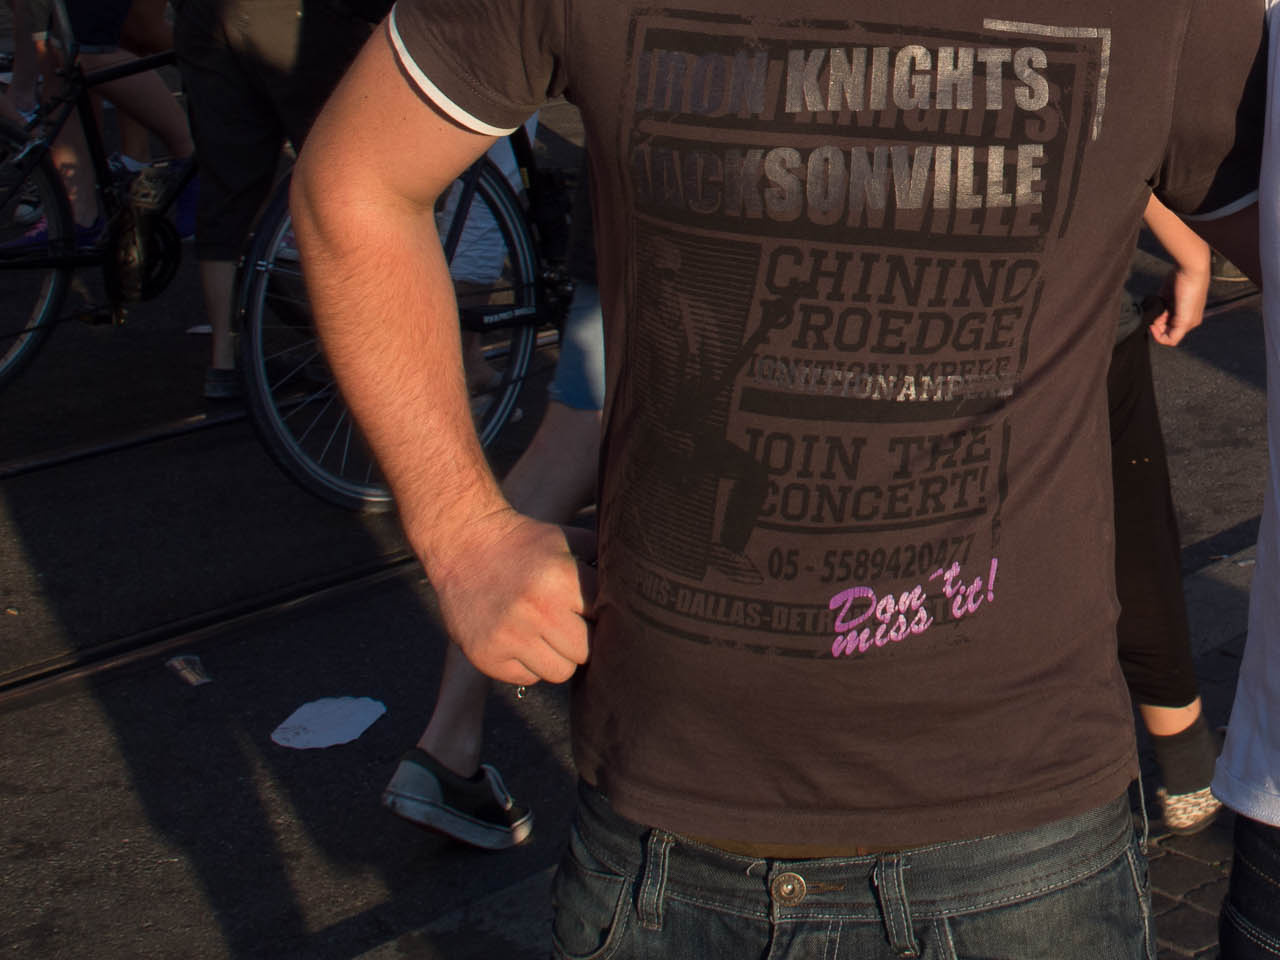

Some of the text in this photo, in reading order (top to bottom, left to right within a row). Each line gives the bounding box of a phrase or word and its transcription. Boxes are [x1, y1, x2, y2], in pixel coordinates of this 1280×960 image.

[785, 44, 1052, 117] KNIGHTS
[760, 298, 1023, 354] PROEDGE
[746, 424, 991, 480] JOIN THE
[762, 465, 989, 523] CONCERT!
[831, 606, 934, 658] miss
